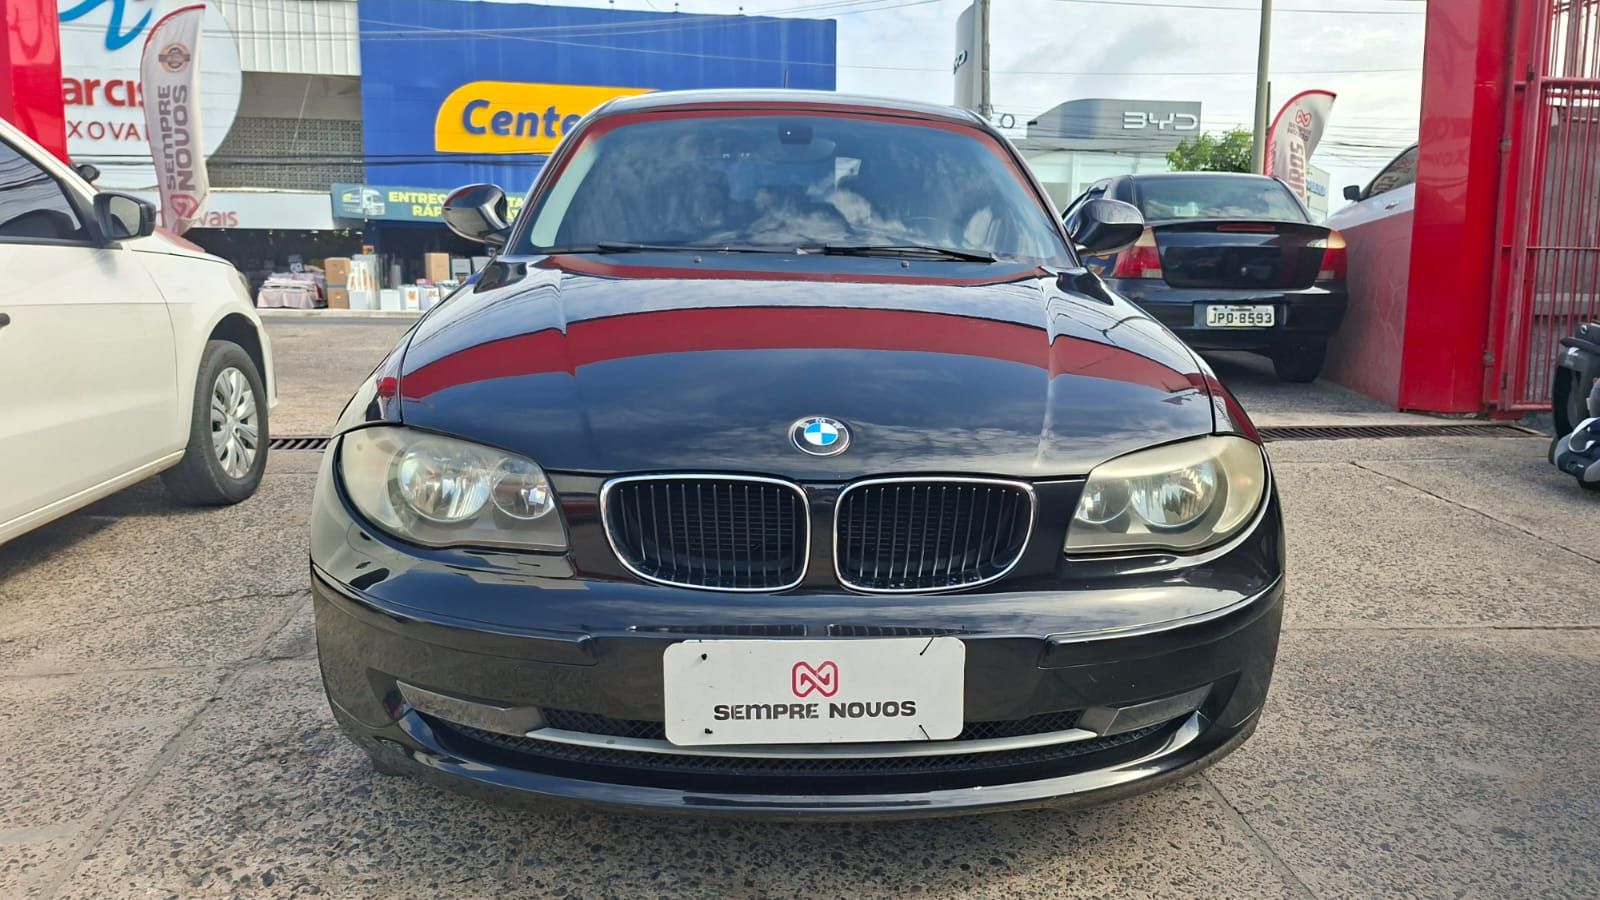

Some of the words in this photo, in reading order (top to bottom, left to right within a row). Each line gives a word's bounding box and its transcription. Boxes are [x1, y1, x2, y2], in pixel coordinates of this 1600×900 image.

[1123, 111, 1198, 130] BYD
[158, 85, 176, 191] SEMPRE
[713, 703, 820, 721] SEMPRE
